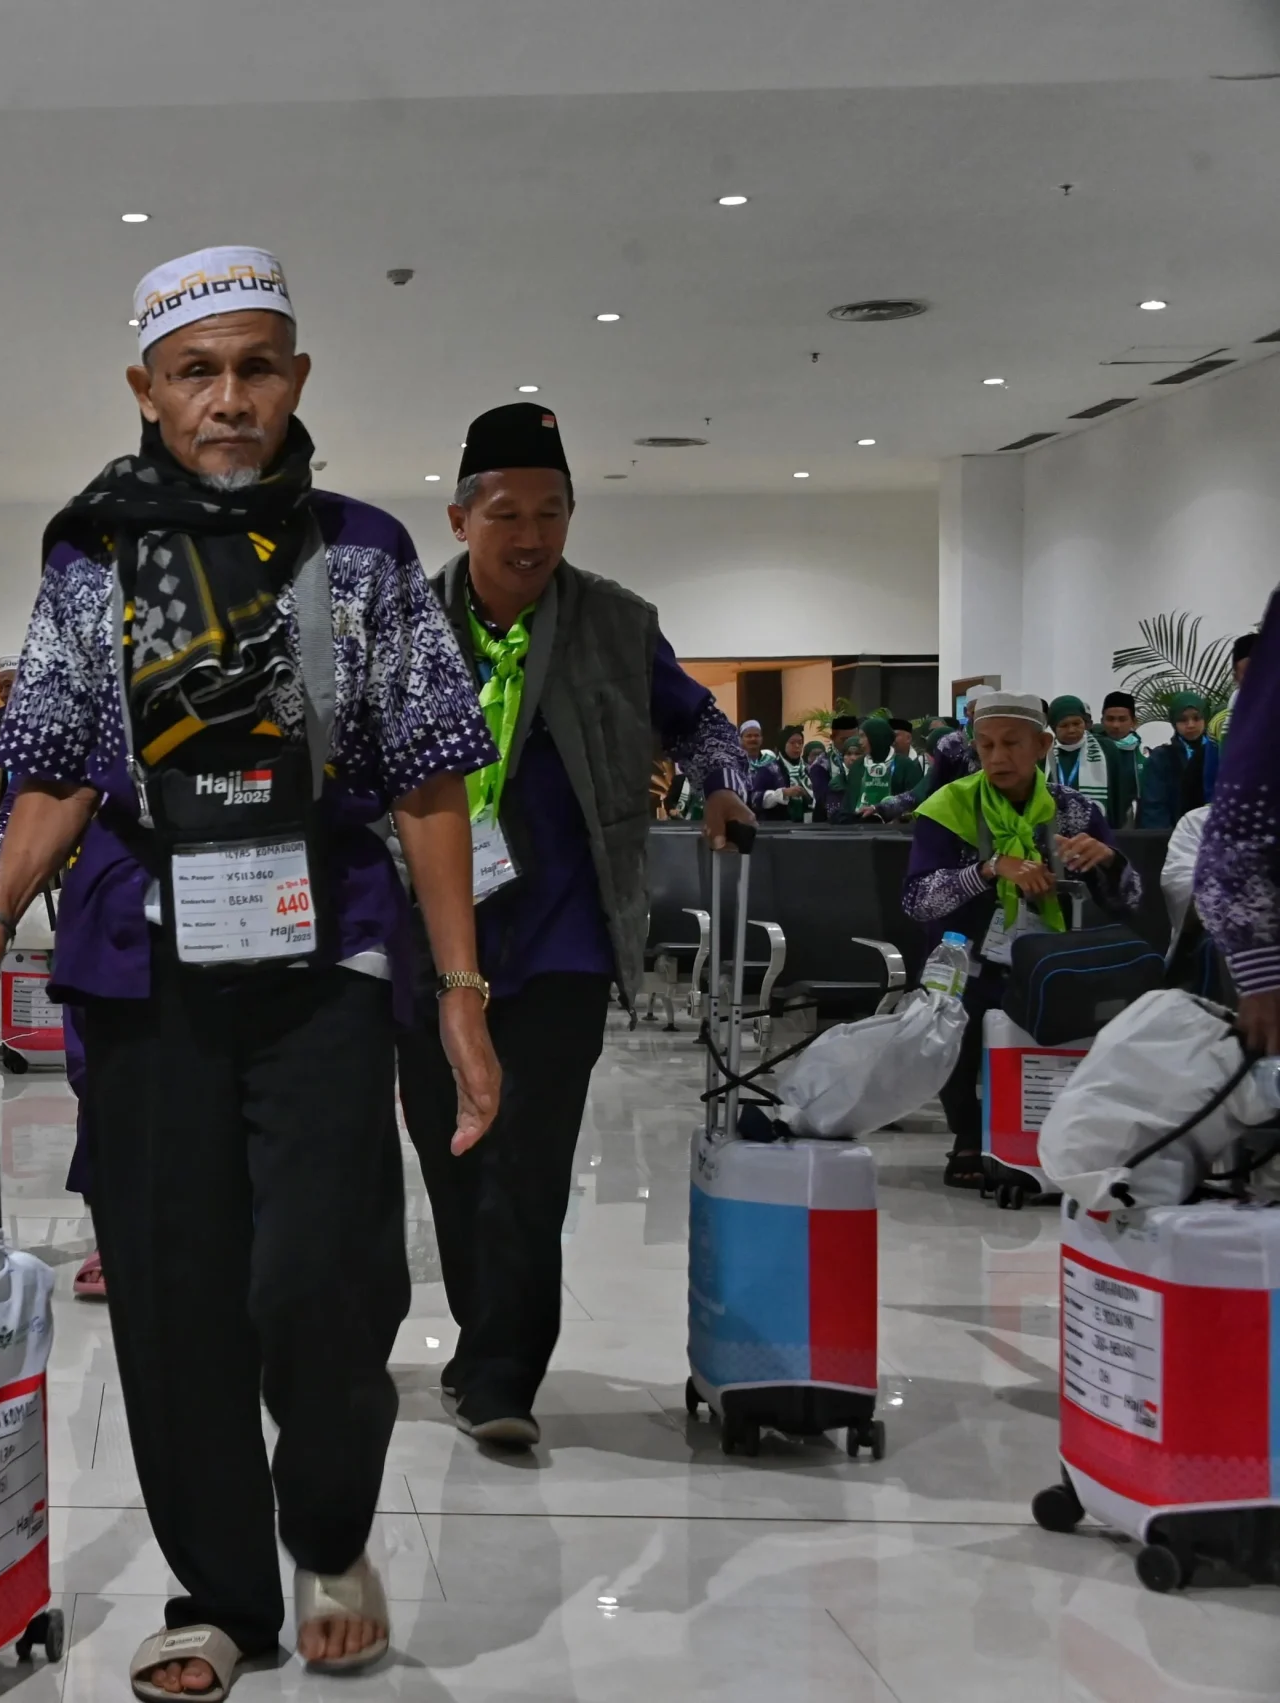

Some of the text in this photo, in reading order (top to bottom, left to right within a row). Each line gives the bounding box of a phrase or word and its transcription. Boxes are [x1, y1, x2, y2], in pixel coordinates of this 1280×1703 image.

[196, 771, 242, 806] Haji
[234, 790, 271, 804] 2025
[277, 892, 309, 915] 440
[270, 925, 295, 943] Haji
